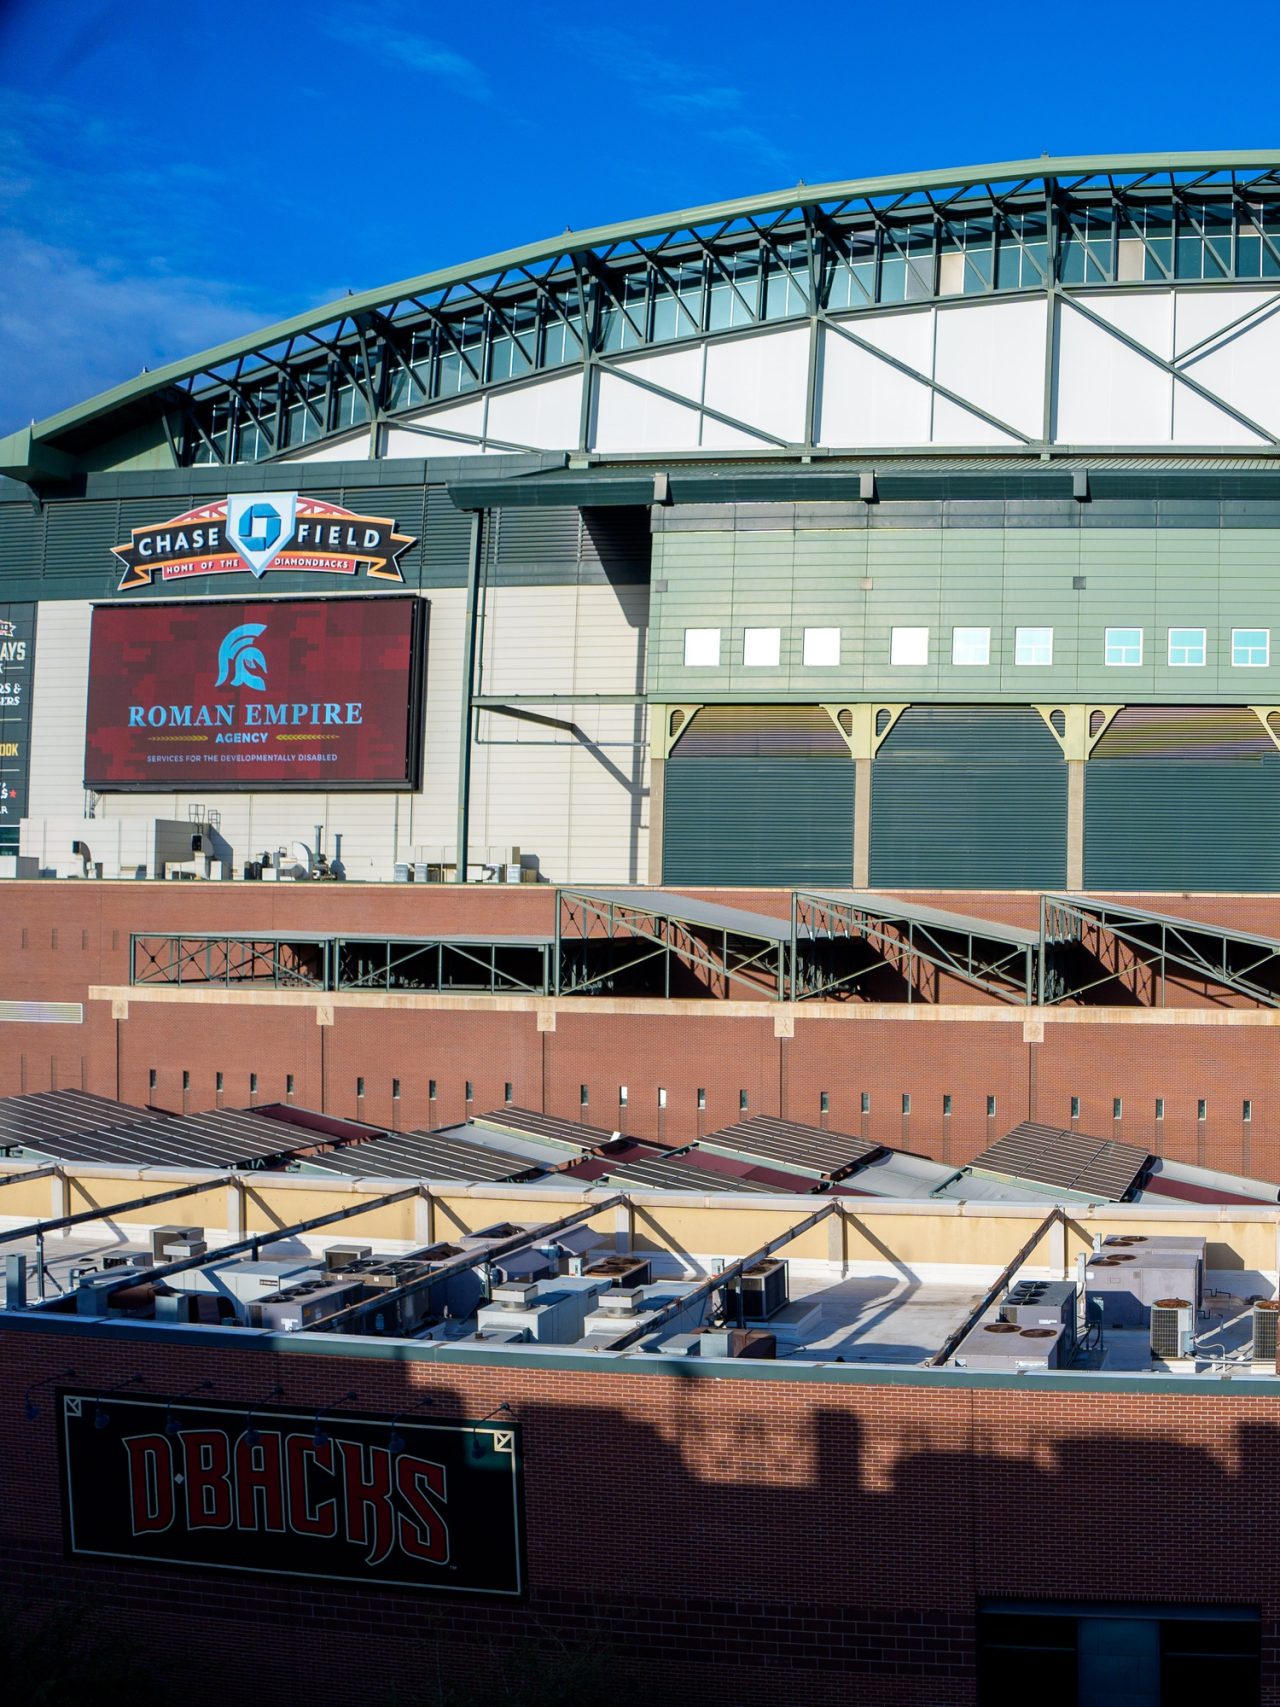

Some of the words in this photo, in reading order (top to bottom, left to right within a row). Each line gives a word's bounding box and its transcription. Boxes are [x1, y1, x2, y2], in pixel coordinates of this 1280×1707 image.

[138, 527, 219, 556] CHASE
[297, 524, 380, 548] FIELD
[166, 563, 195, 574] HOME
[200, 561, 214, 569] OF
[220, 559, 239, 568] THE
[274, 558, 348, 569] DIAMONDBACKS
[127, 704, 236, 728] ROMAN
[244, 702, 363, 726] EMPIRE
[215, 732, 269, 744] AGENCY
[147, 755, 184, 763] SERVICES
[185, 755, 201, 763] FOR
[203, 754, 218, 762] THE
[220, 754, 295, 762] DEVELOPMENTALLY
[298, 753, 338, 762] DISABLED
